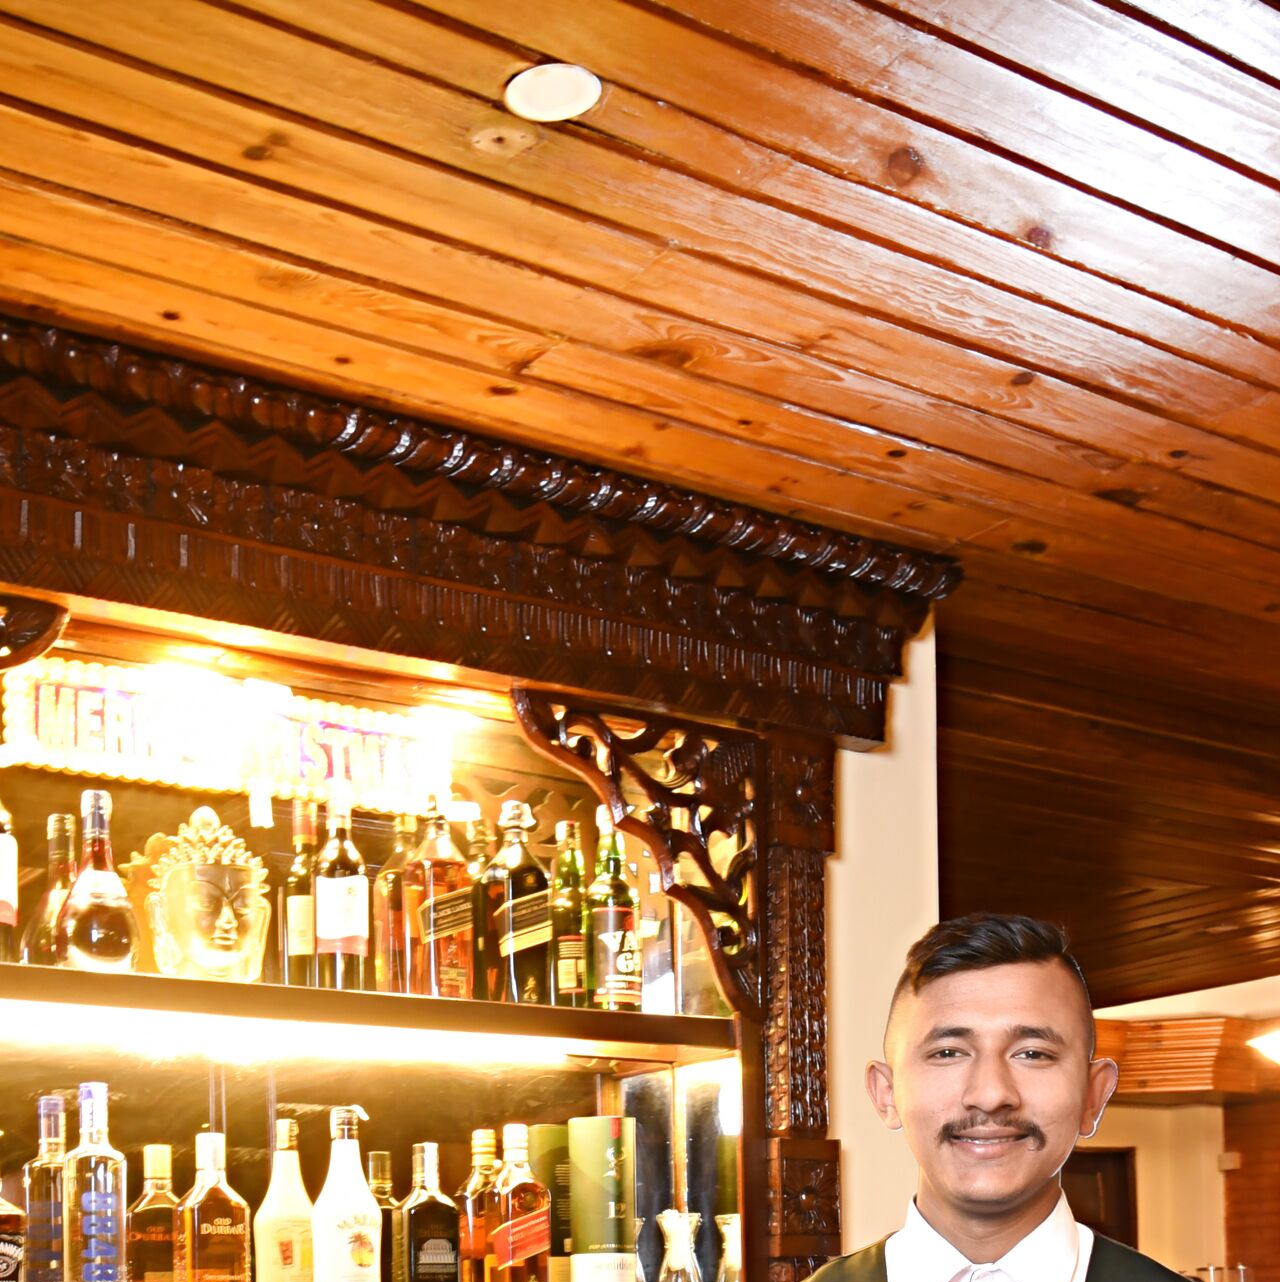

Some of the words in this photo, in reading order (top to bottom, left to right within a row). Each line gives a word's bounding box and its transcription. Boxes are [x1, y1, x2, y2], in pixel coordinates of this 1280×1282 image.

[598, 931, 641, 952] VA
[608, 1201, 626, 1218] 12
[82, 1191, 117, 1282] 8848
